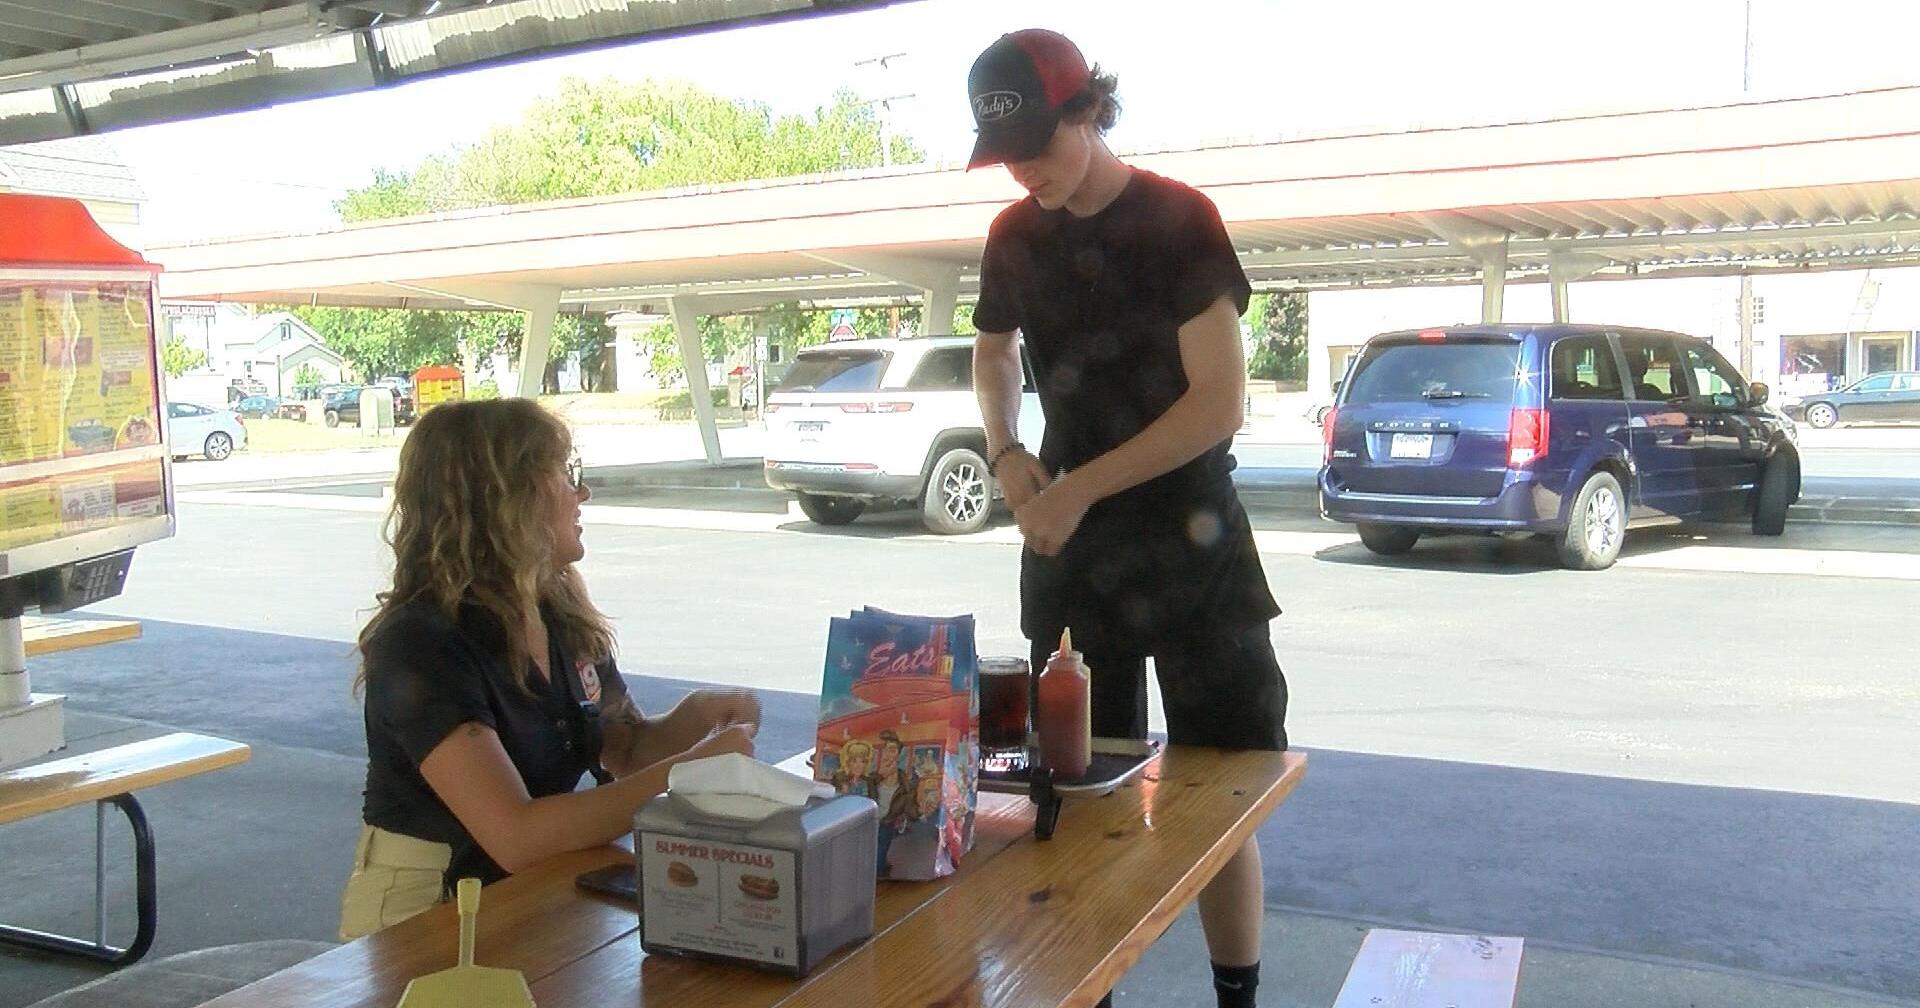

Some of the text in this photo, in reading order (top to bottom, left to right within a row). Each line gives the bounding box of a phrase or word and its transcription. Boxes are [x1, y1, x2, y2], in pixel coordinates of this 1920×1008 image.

[975, 95, 1014, 117] Rudy's
[864, 641, 936, 680] Eats
[655, 839, 775, 870] SUMMER SPECIALS
